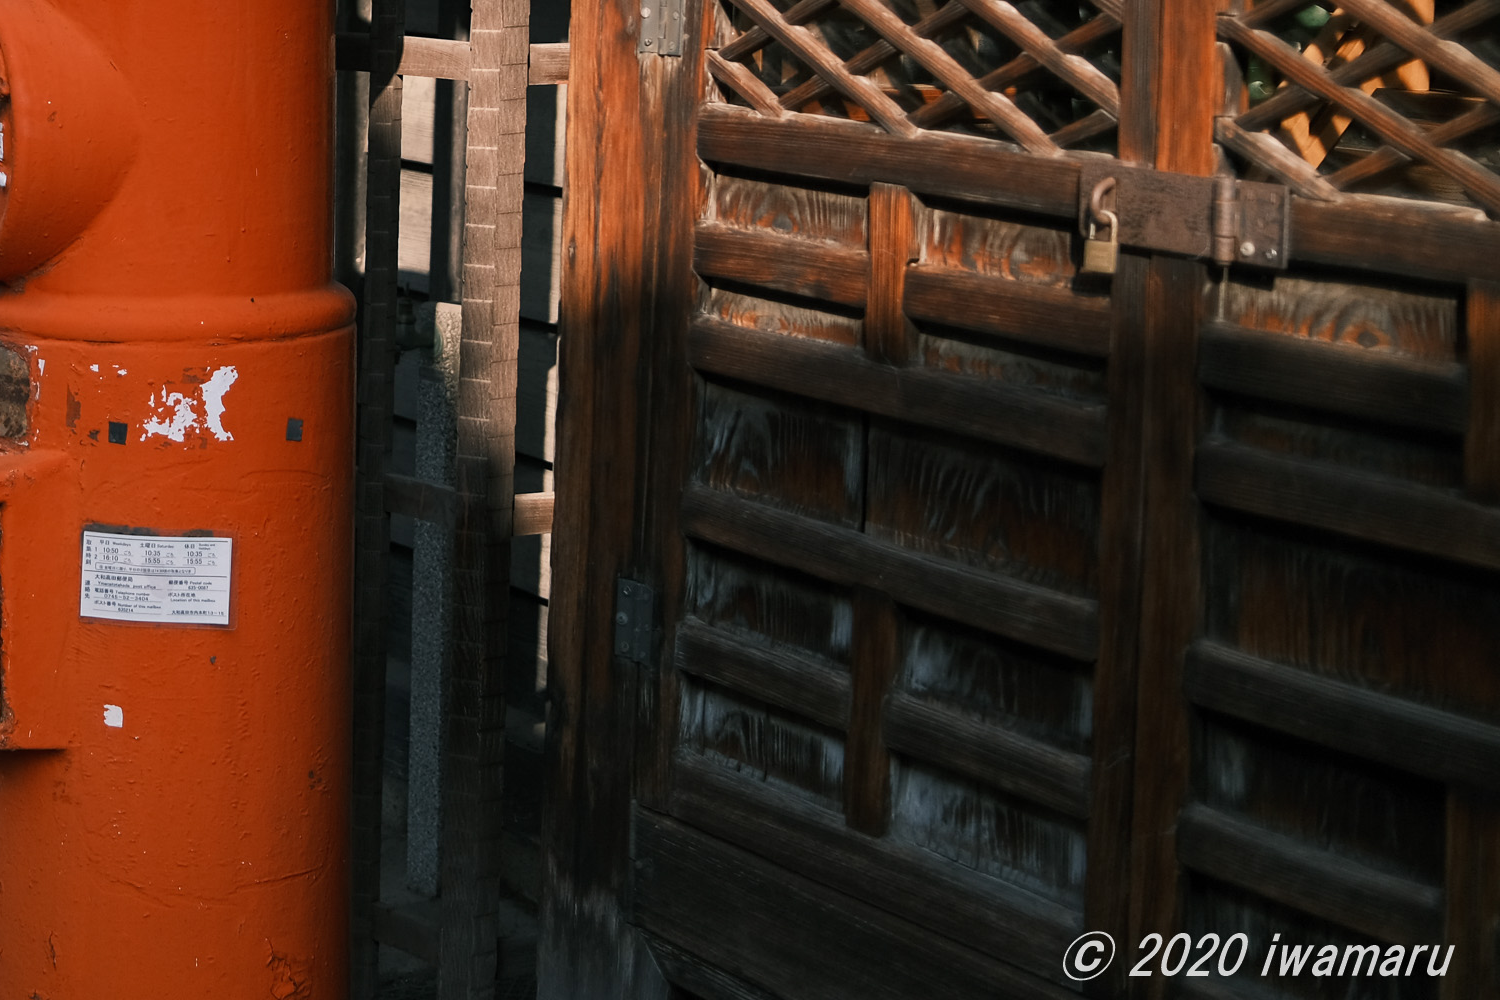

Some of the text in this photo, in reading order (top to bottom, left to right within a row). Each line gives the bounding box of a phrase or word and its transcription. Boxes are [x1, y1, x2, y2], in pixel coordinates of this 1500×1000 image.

[95, 574, 134, 582] 大和高田郵便局
